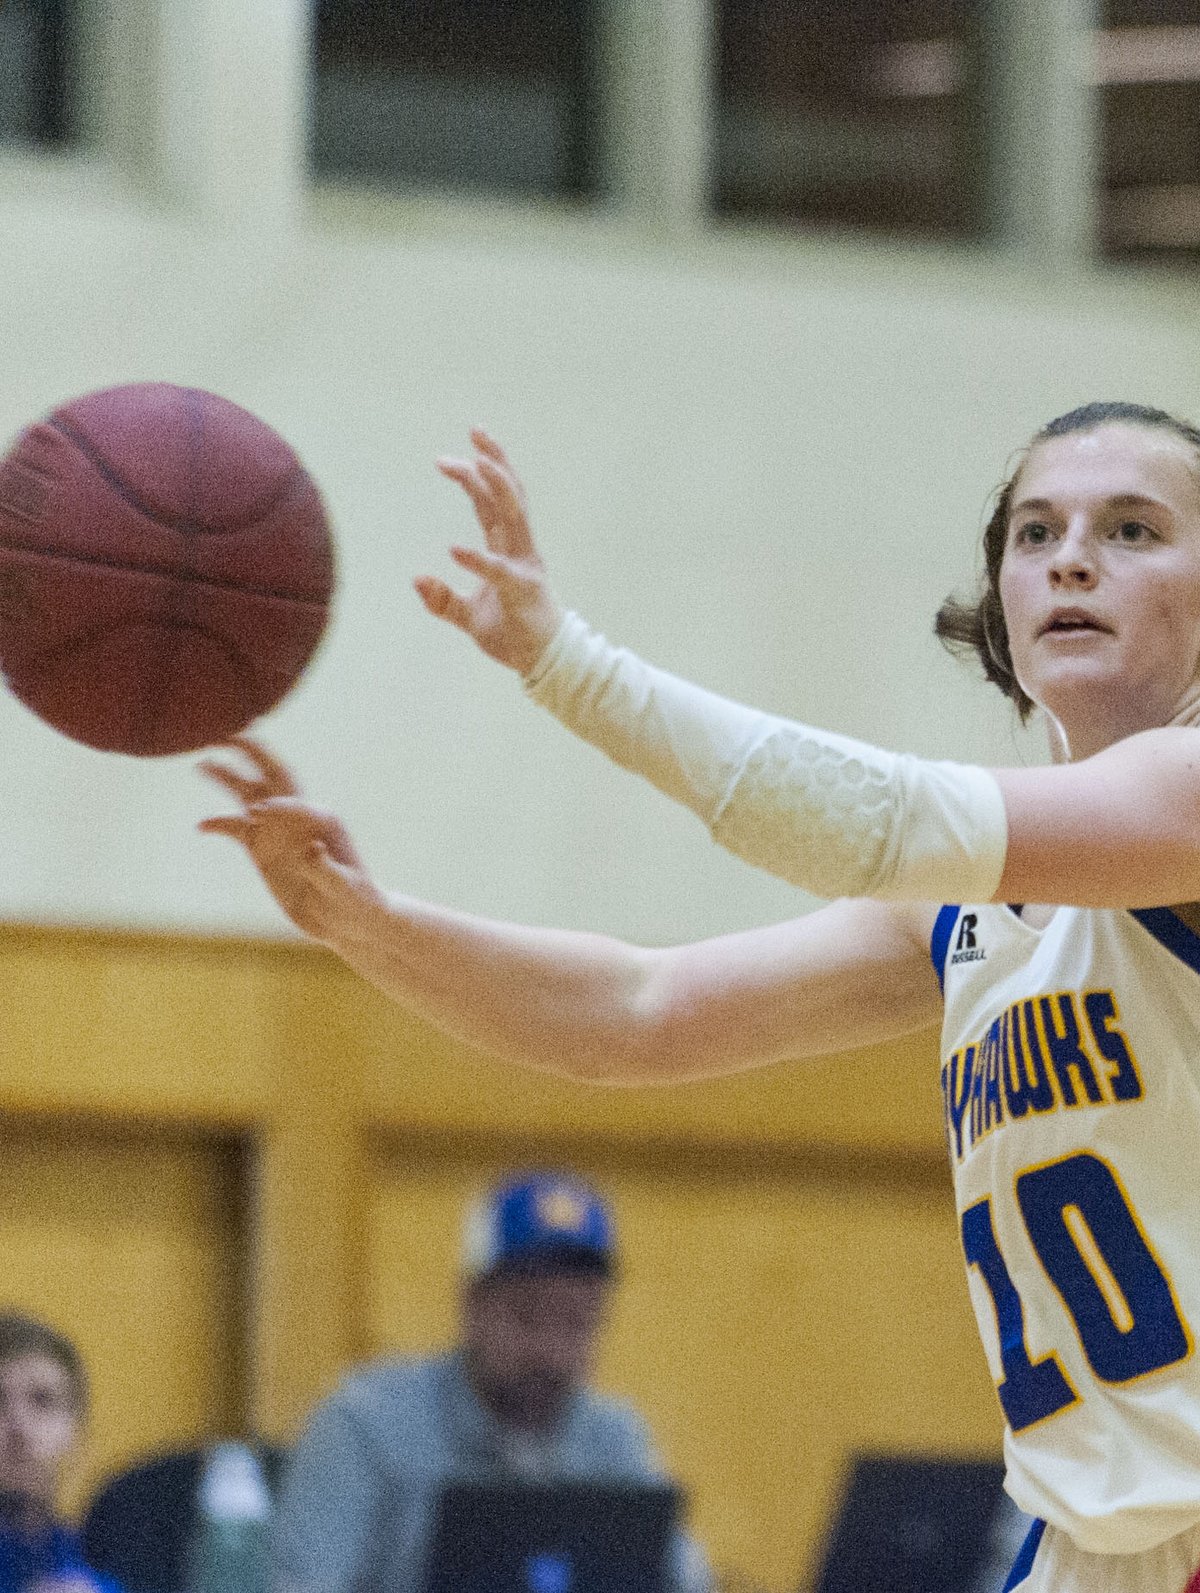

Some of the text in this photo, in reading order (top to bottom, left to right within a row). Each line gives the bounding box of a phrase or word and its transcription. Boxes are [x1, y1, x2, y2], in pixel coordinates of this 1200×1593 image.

[956, 913, 978, 950] R
[941, 988, 1146, 1164] YHAWKS
[960, 1148, 1195, 1437] 10
